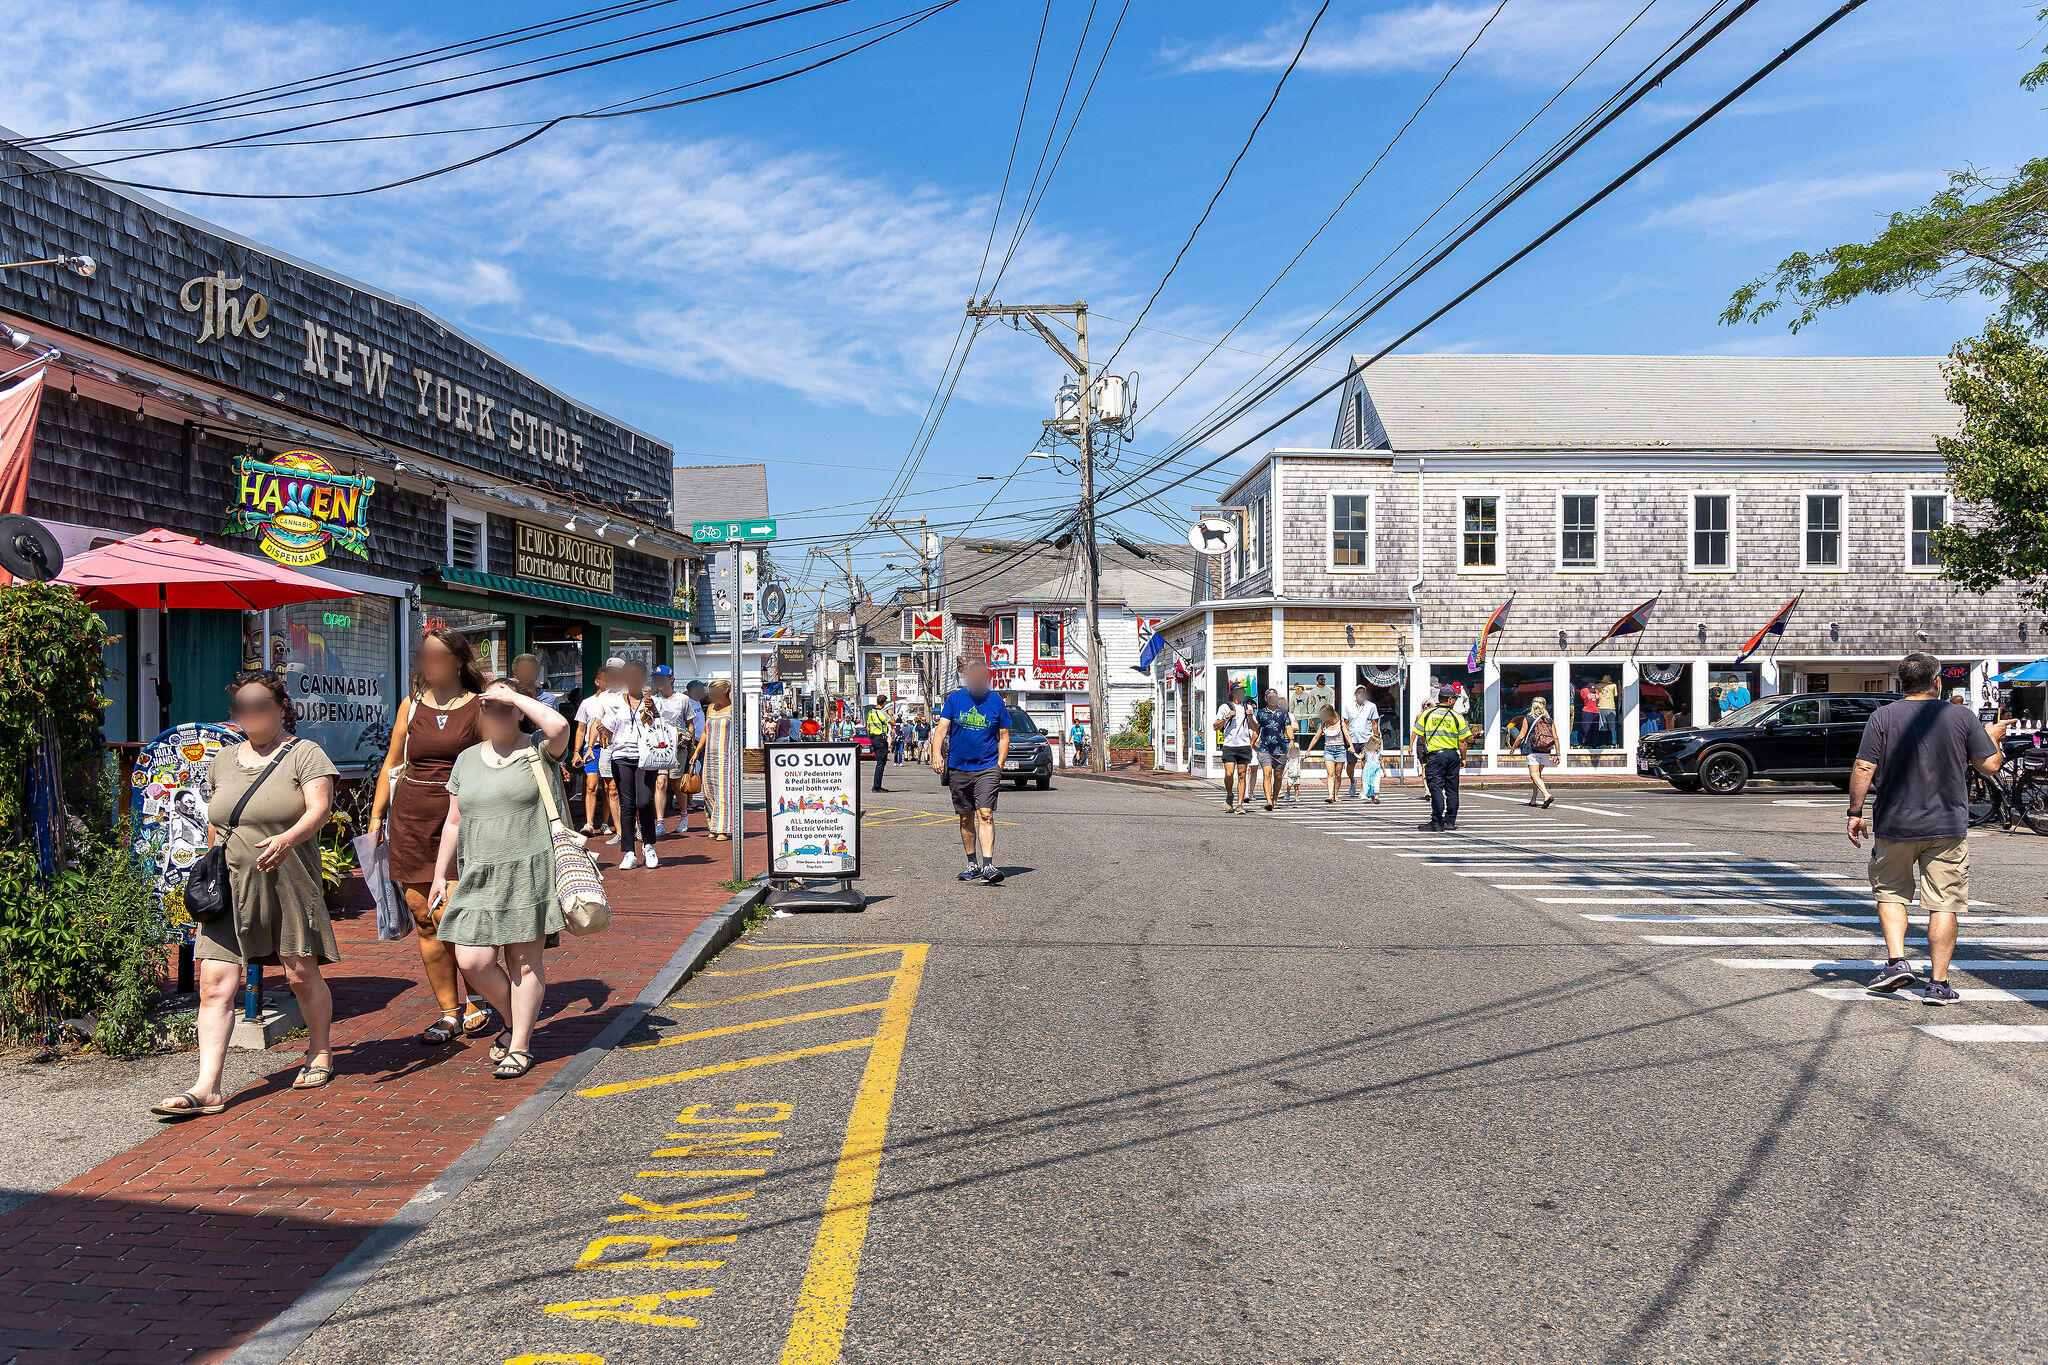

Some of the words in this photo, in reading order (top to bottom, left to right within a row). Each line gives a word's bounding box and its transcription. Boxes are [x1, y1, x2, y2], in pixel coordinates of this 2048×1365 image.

[180, 270, 270, 343] The
[302, 319, 393, 399] NEW
[412, 367, 495, 441] YORK
[510, 407, 584, 473] STORE
[279, 517, 313, 529] CANNABIS
[729, 525, 739, 536] P
[265, 543, 322, 563] DISPENSARY
[519, 525, 555, 557] LEWIS
[558, 536, 612, 569] BROTHERS
[519, 554, 570, 581] HOMEMADE
[571, 565, 585, 585] ICE
[585, 569, 612, 590] CREAM
[1947, 668, 1964, 676] ATM
[299, 674, 378, 697] CANNABIS
[992, 679, 1012, 689] POT
[1039, 680, 1086, 690] STEAKS
[295, 702, 383, 723] DISPENSARY
[153, 746, 174, 757] HULK
[152, 754, 179, 767] HANDS
[774, 753, 800, 767] GO
[804, 753, 852, 767] SLOW
